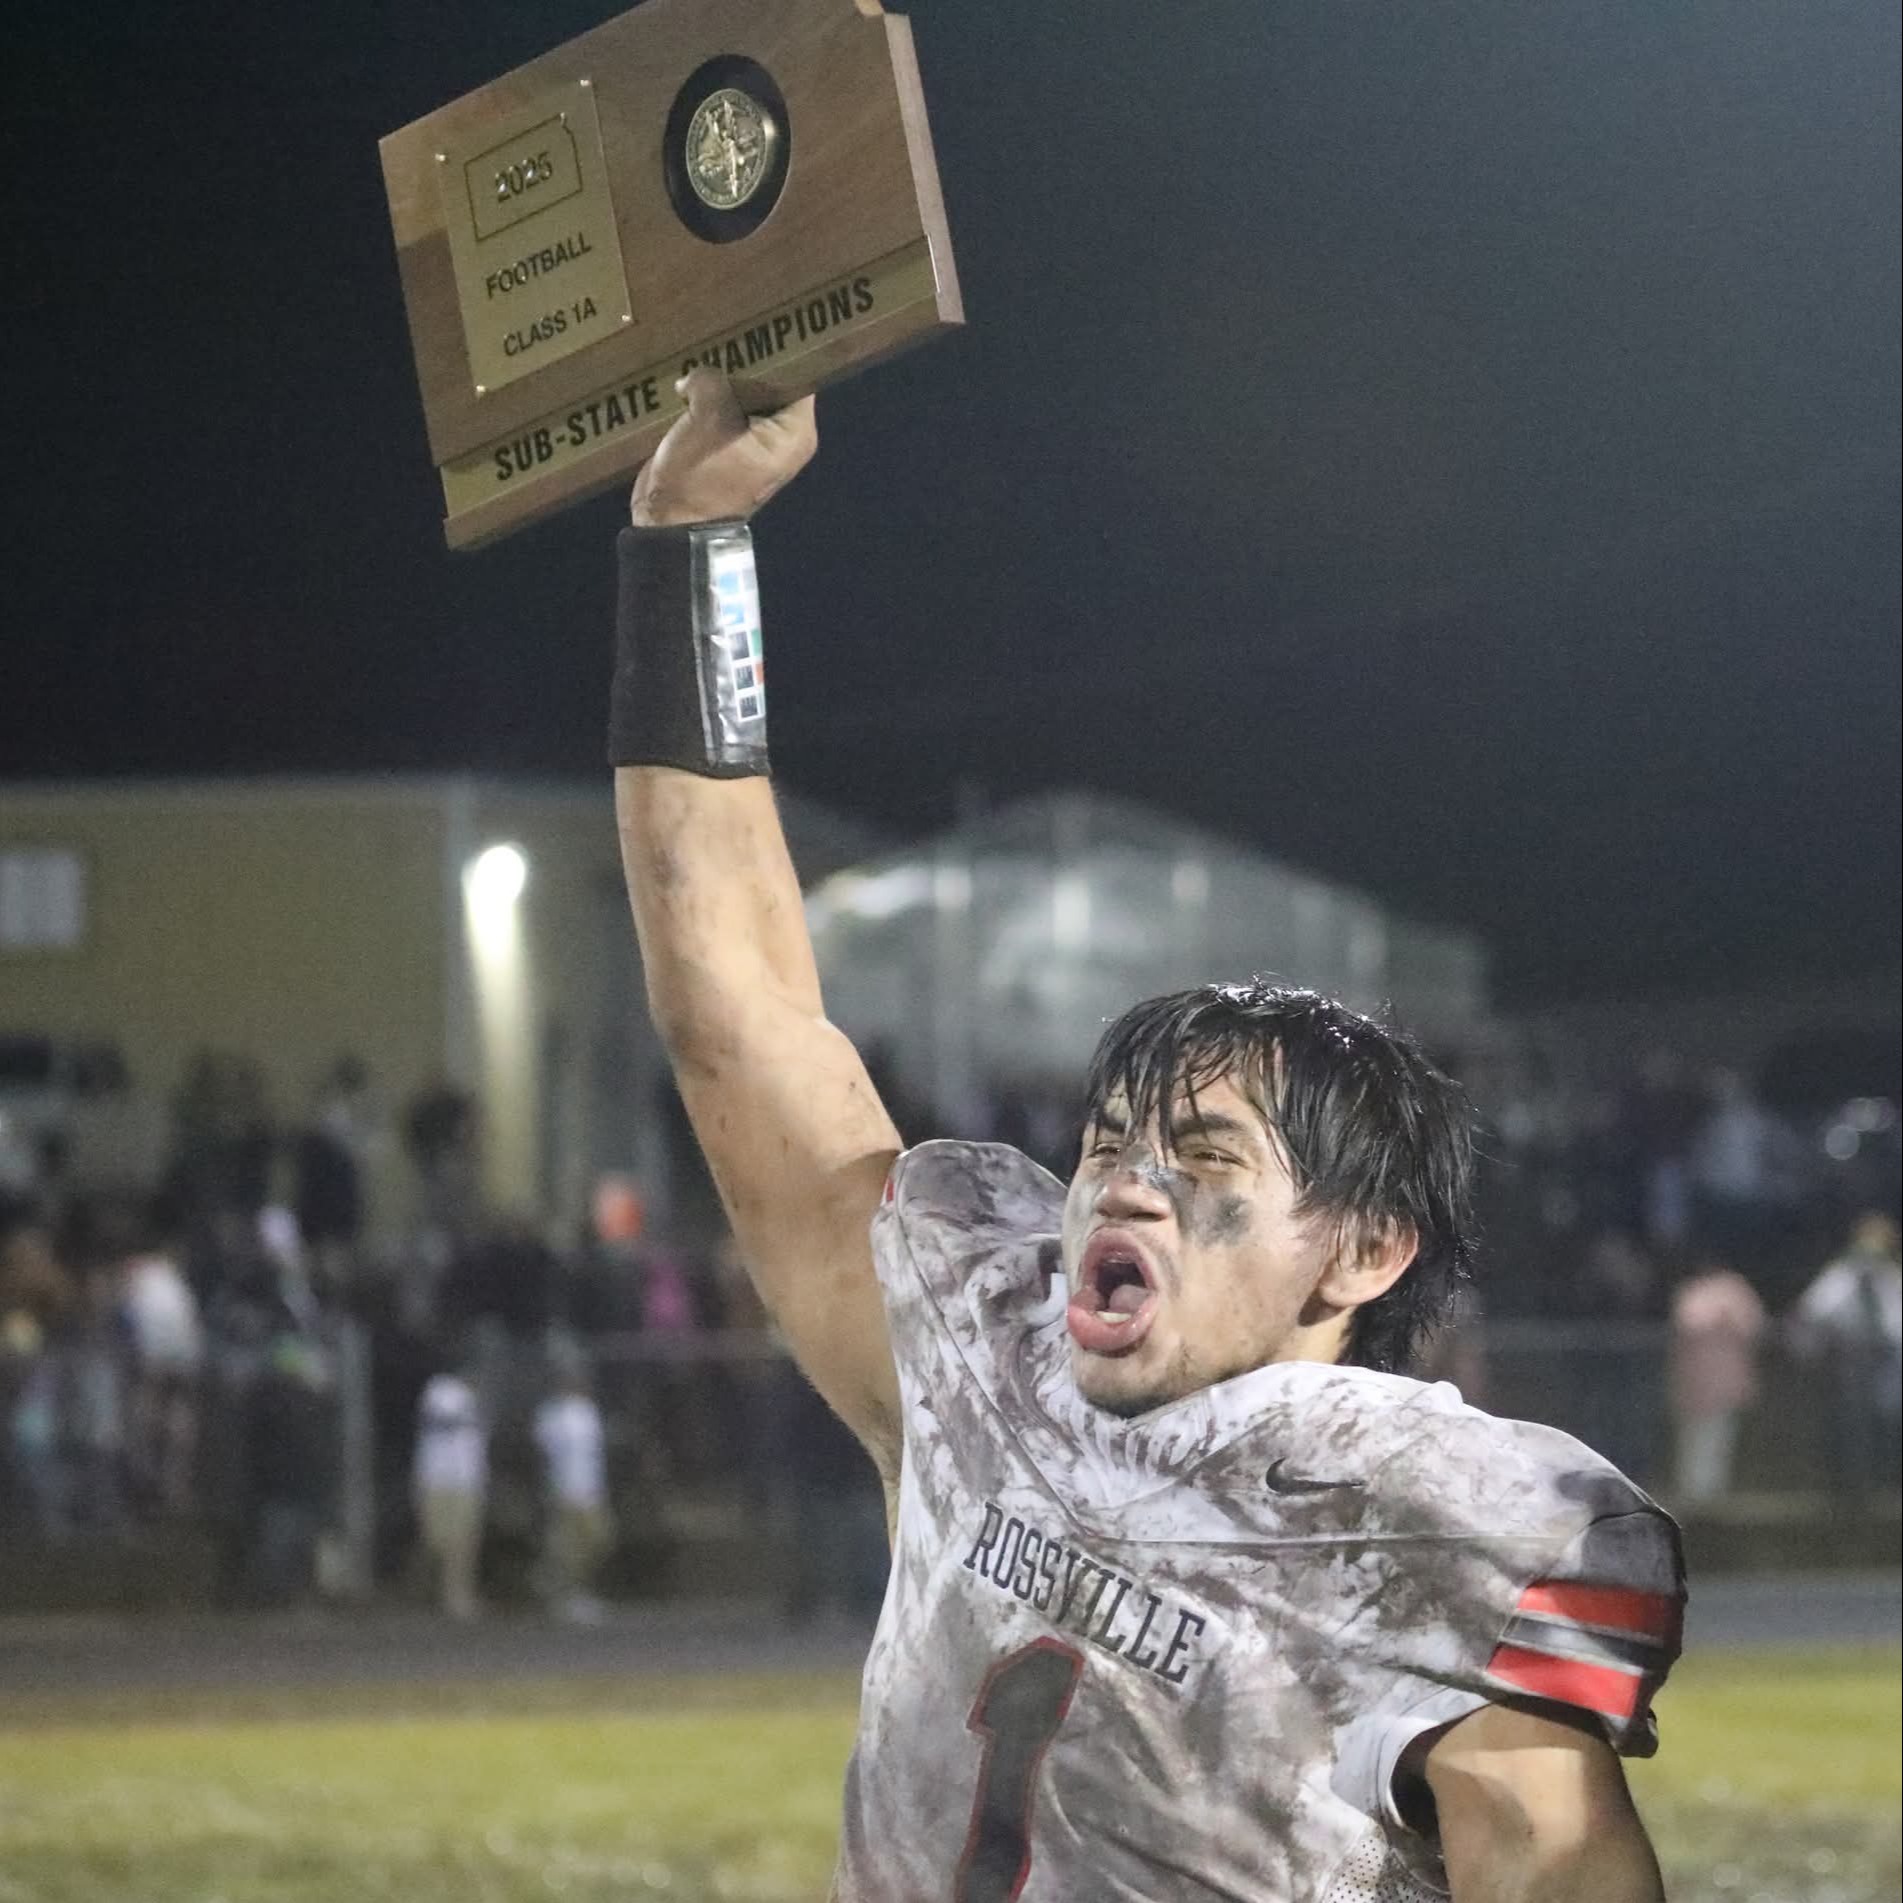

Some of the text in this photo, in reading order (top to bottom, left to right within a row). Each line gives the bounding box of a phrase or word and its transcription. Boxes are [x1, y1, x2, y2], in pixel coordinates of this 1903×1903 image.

[494, 152, 553, 203] 2025
[485, 232, 593, 299] FOOTBALL
[503, 297, 597, 357] CLASS 1A
[494, 375, 661, 481] SUB-STATE
[963, 1502, 1206, 1686] ROSSVILLE
[953, 1635, 1085, 1903] 1
